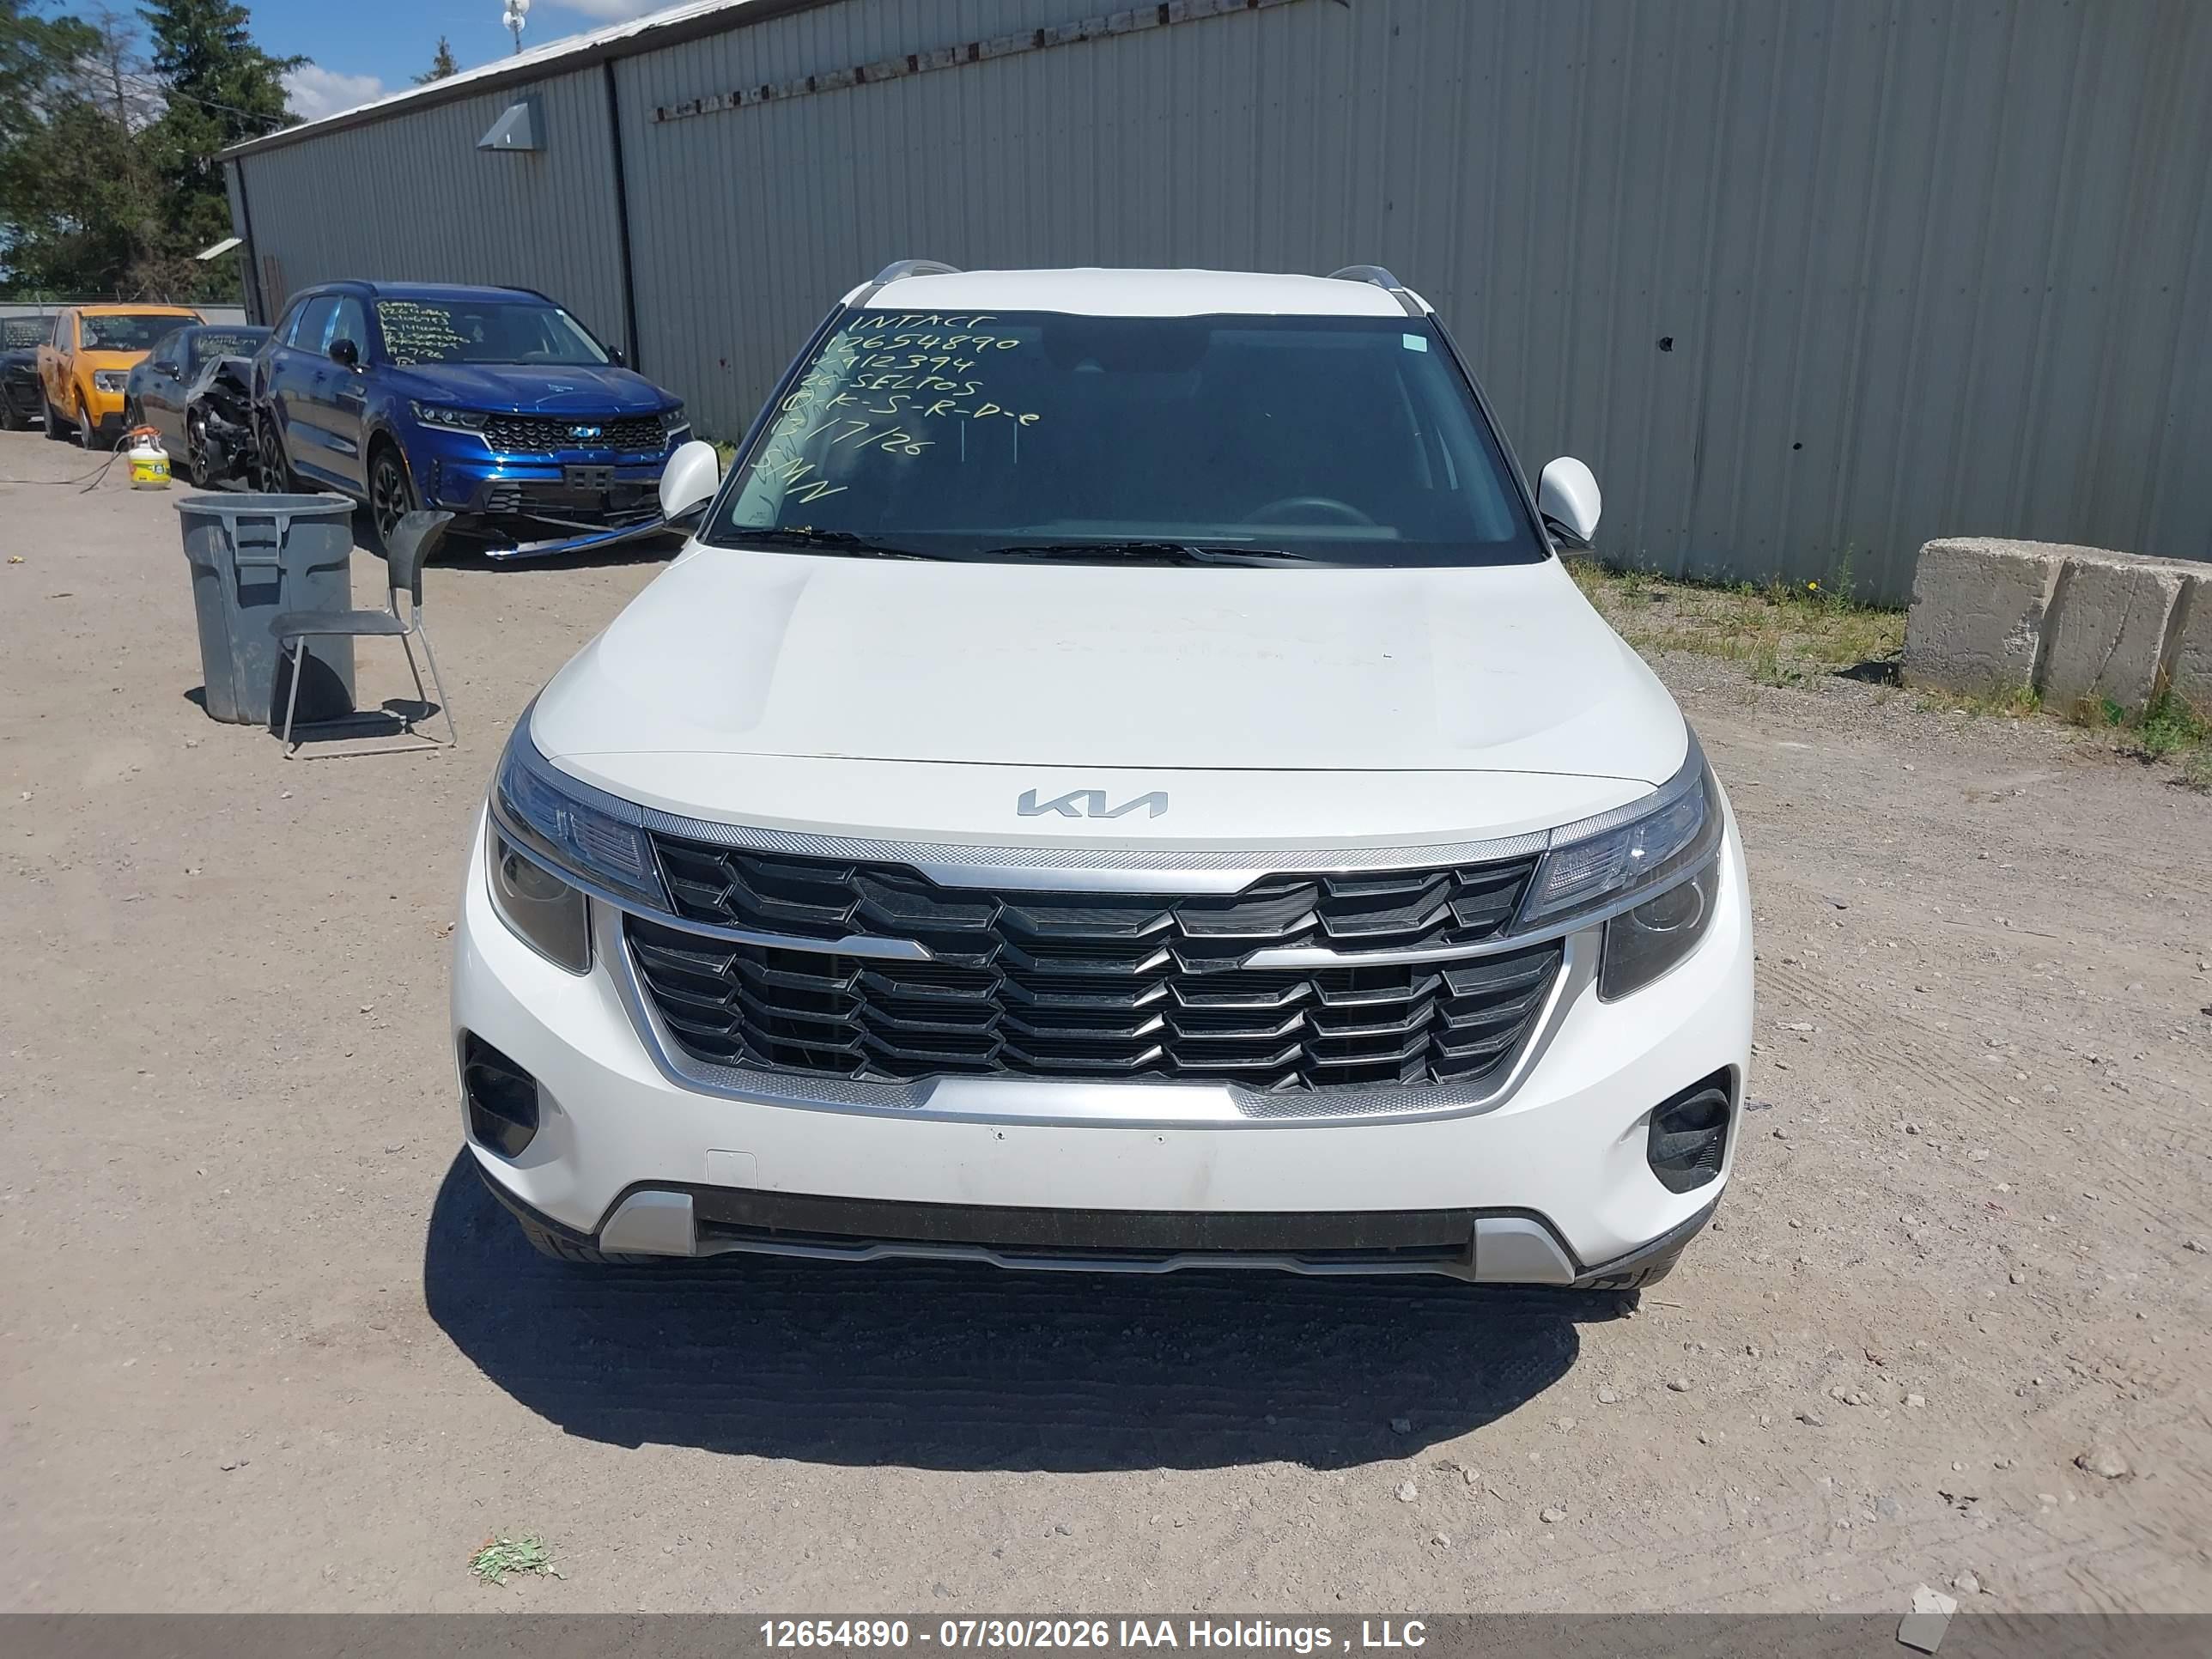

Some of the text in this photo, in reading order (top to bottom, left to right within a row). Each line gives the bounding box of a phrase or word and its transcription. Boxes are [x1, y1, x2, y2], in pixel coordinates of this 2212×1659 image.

[848, 314, 999, 332] INTACT
[824, 333, 1021, 354] 12654890
[1017, 788, 1169, 819] KIA
